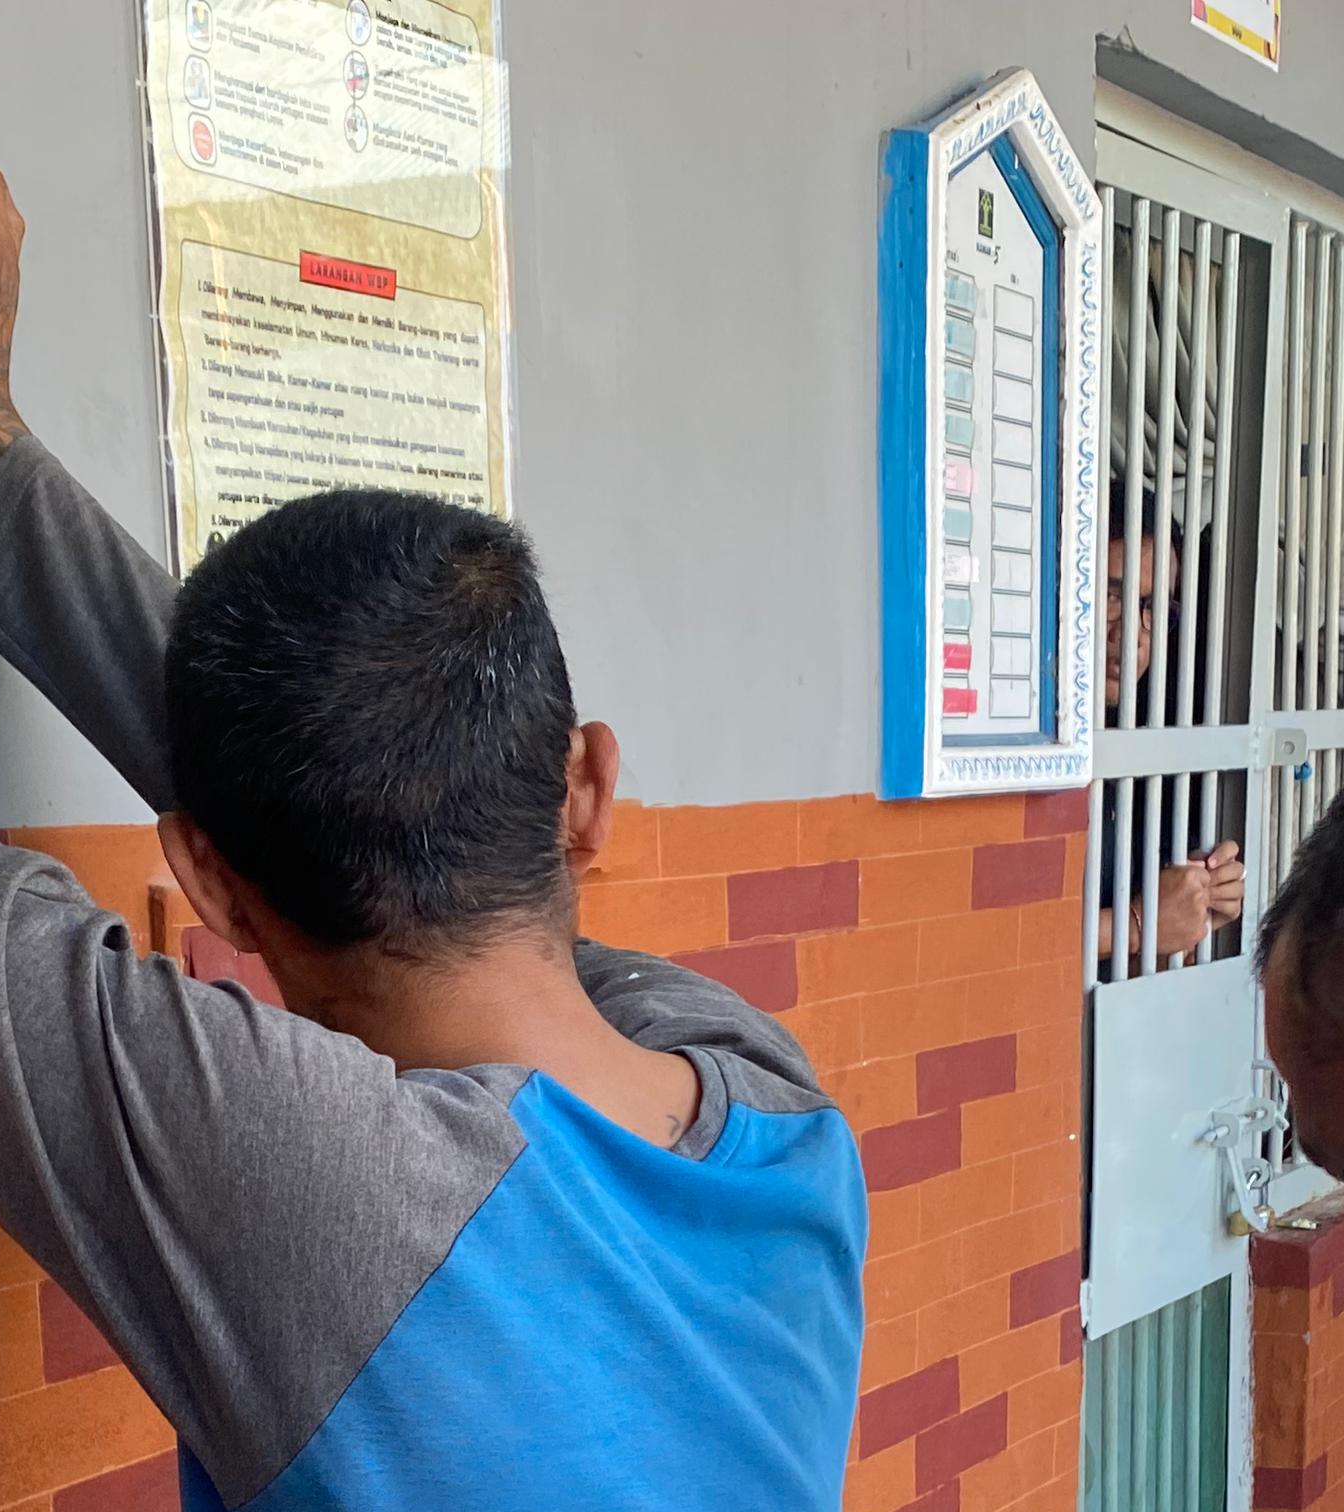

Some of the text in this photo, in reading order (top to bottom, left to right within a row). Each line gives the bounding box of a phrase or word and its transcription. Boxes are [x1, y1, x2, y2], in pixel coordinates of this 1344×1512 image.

[310, 261, 388, 288] LARANGAN WBP
[358, 312, 369, 324] dan
[443, 331, 457, 343] yang
